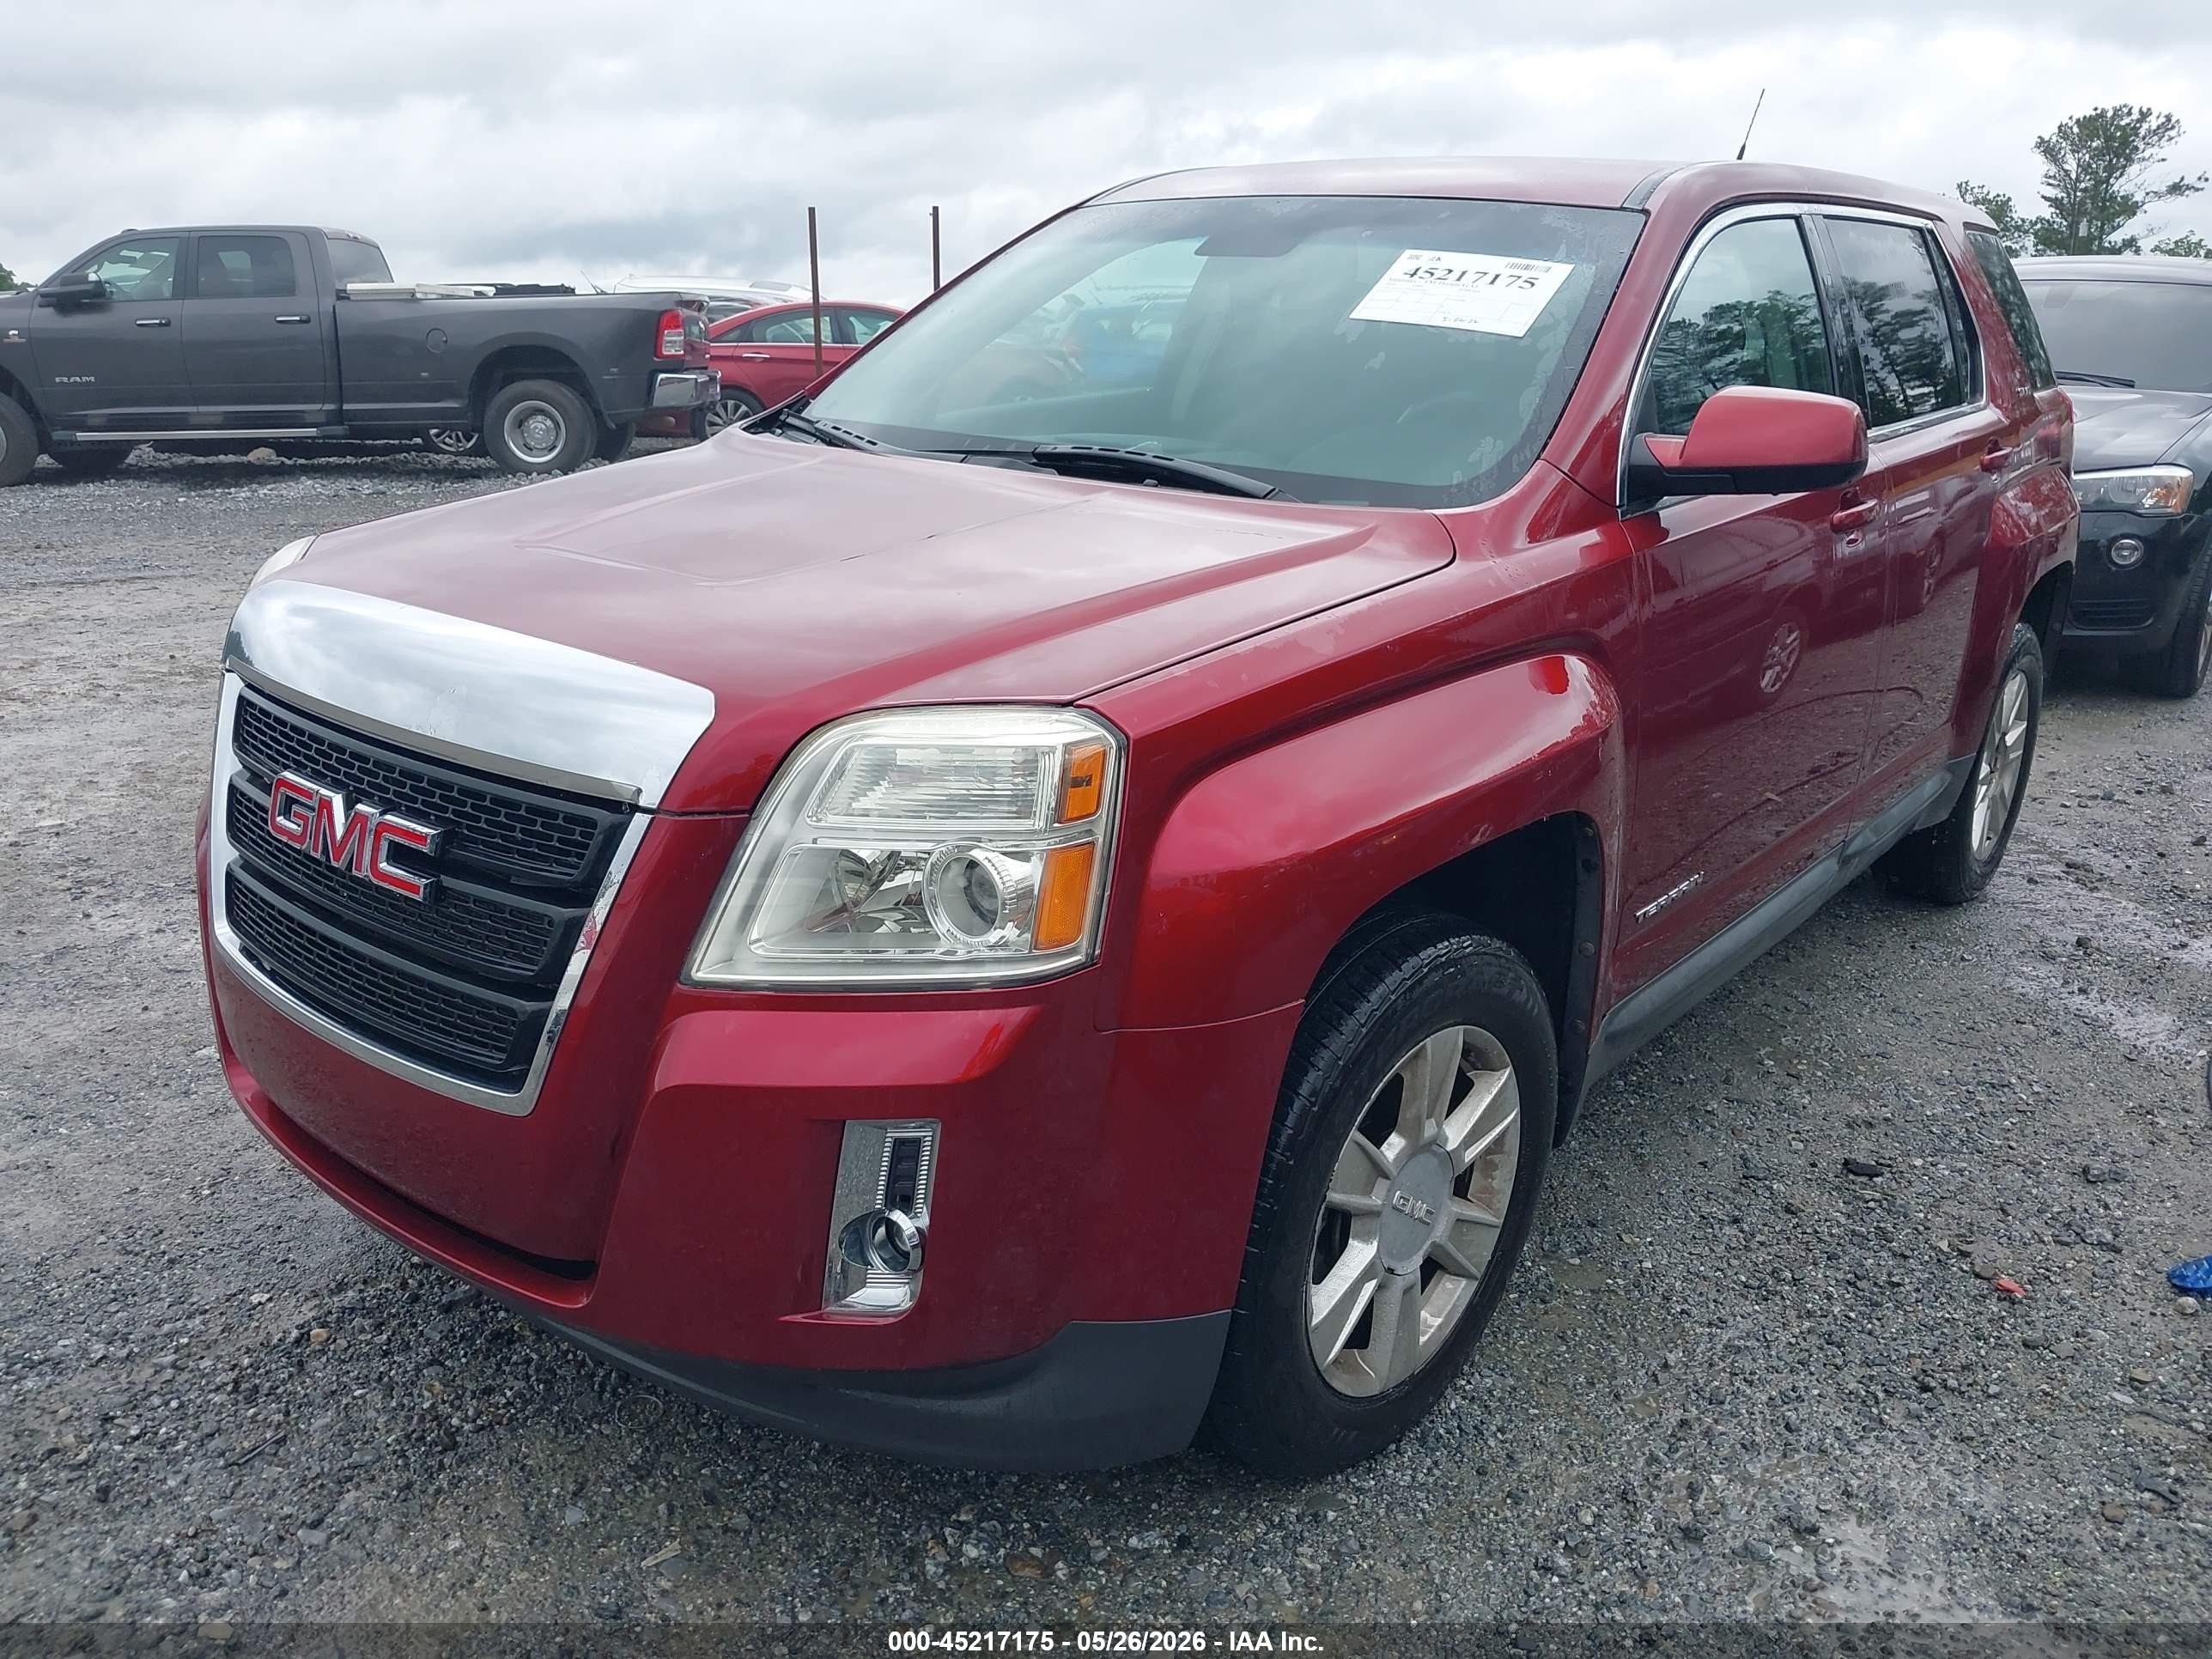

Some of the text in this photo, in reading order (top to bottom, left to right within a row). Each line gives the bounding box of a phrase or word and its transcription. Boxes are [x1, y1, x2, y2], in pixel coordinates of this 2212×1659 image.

[1403, 265, 1540, 290] 45217175
[268, 771, 442, 902] GMC
[1392, 1190, 1437, 1226] GMC
